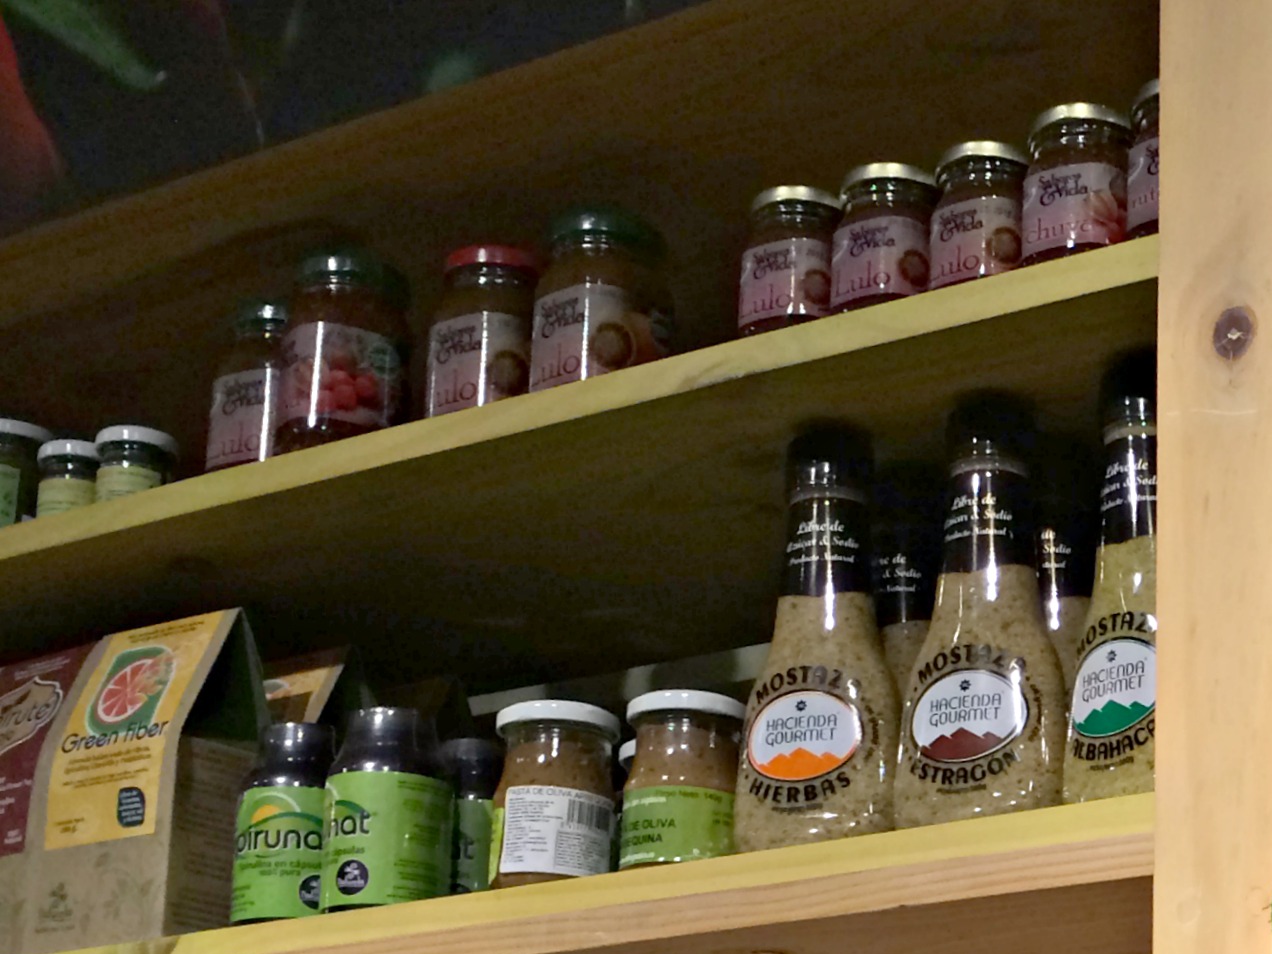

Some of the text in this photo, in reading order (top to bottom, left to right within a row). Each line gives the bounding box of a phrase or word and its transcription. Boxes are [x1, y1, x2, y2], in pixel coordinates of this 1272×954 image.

[836, 261, 891, 297] Lulo
[1077, 611, 1150, 655] MOSTAZ
[1083, 661, 1145, 684] HACIENDA
[1082, 675, 1145, 702] GOURMET
[930, 694, 1002, 712] HACIENDA
[766, 714, 837, 731] HACIENDA
[929, 708, 1000, 727] GOURMET
[61, 721, 169, 753] Green fiber
[766, 727, 837, 746] GOURMET
[546, 788, 572, 797] OLIVA
[749, 772, 850, 803] HIERBAS
[642, 818, 676, 829] OLIVA
